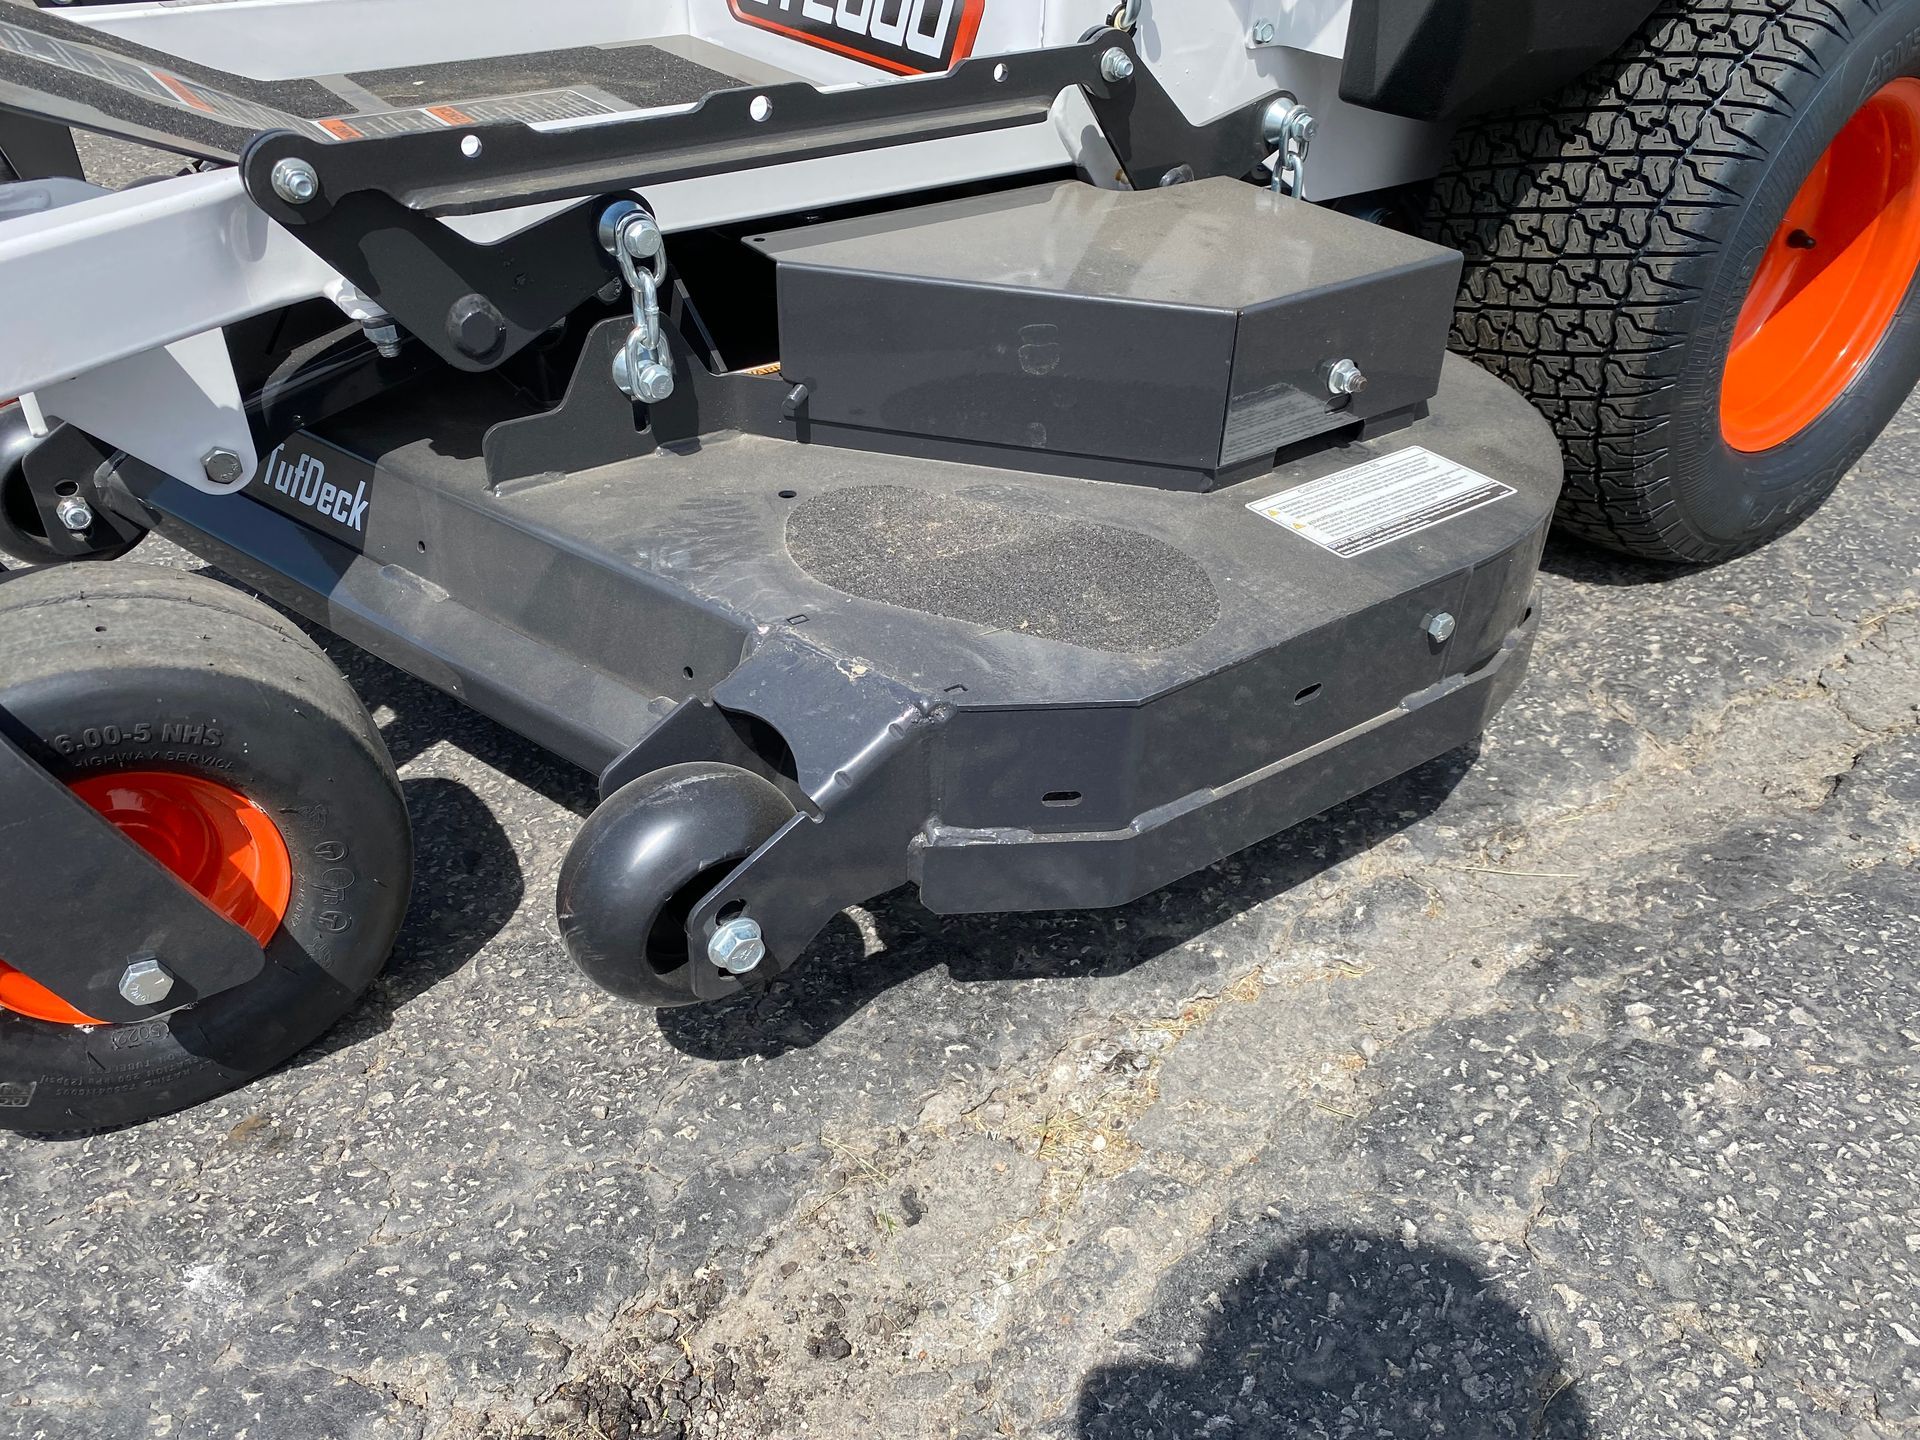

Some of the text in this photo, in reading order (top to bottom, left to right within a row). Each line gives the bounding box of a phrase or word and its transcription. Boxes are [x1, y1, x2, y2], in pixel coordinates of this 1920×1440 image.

[263, 442, 369, 532] TufDeck
[1297, 478, 1332, 494] California
[1332, 465, 1370, 484] Proposition
[161, 722, 224, 747] NHS
[118, 1023, 161, 1046] 5022
